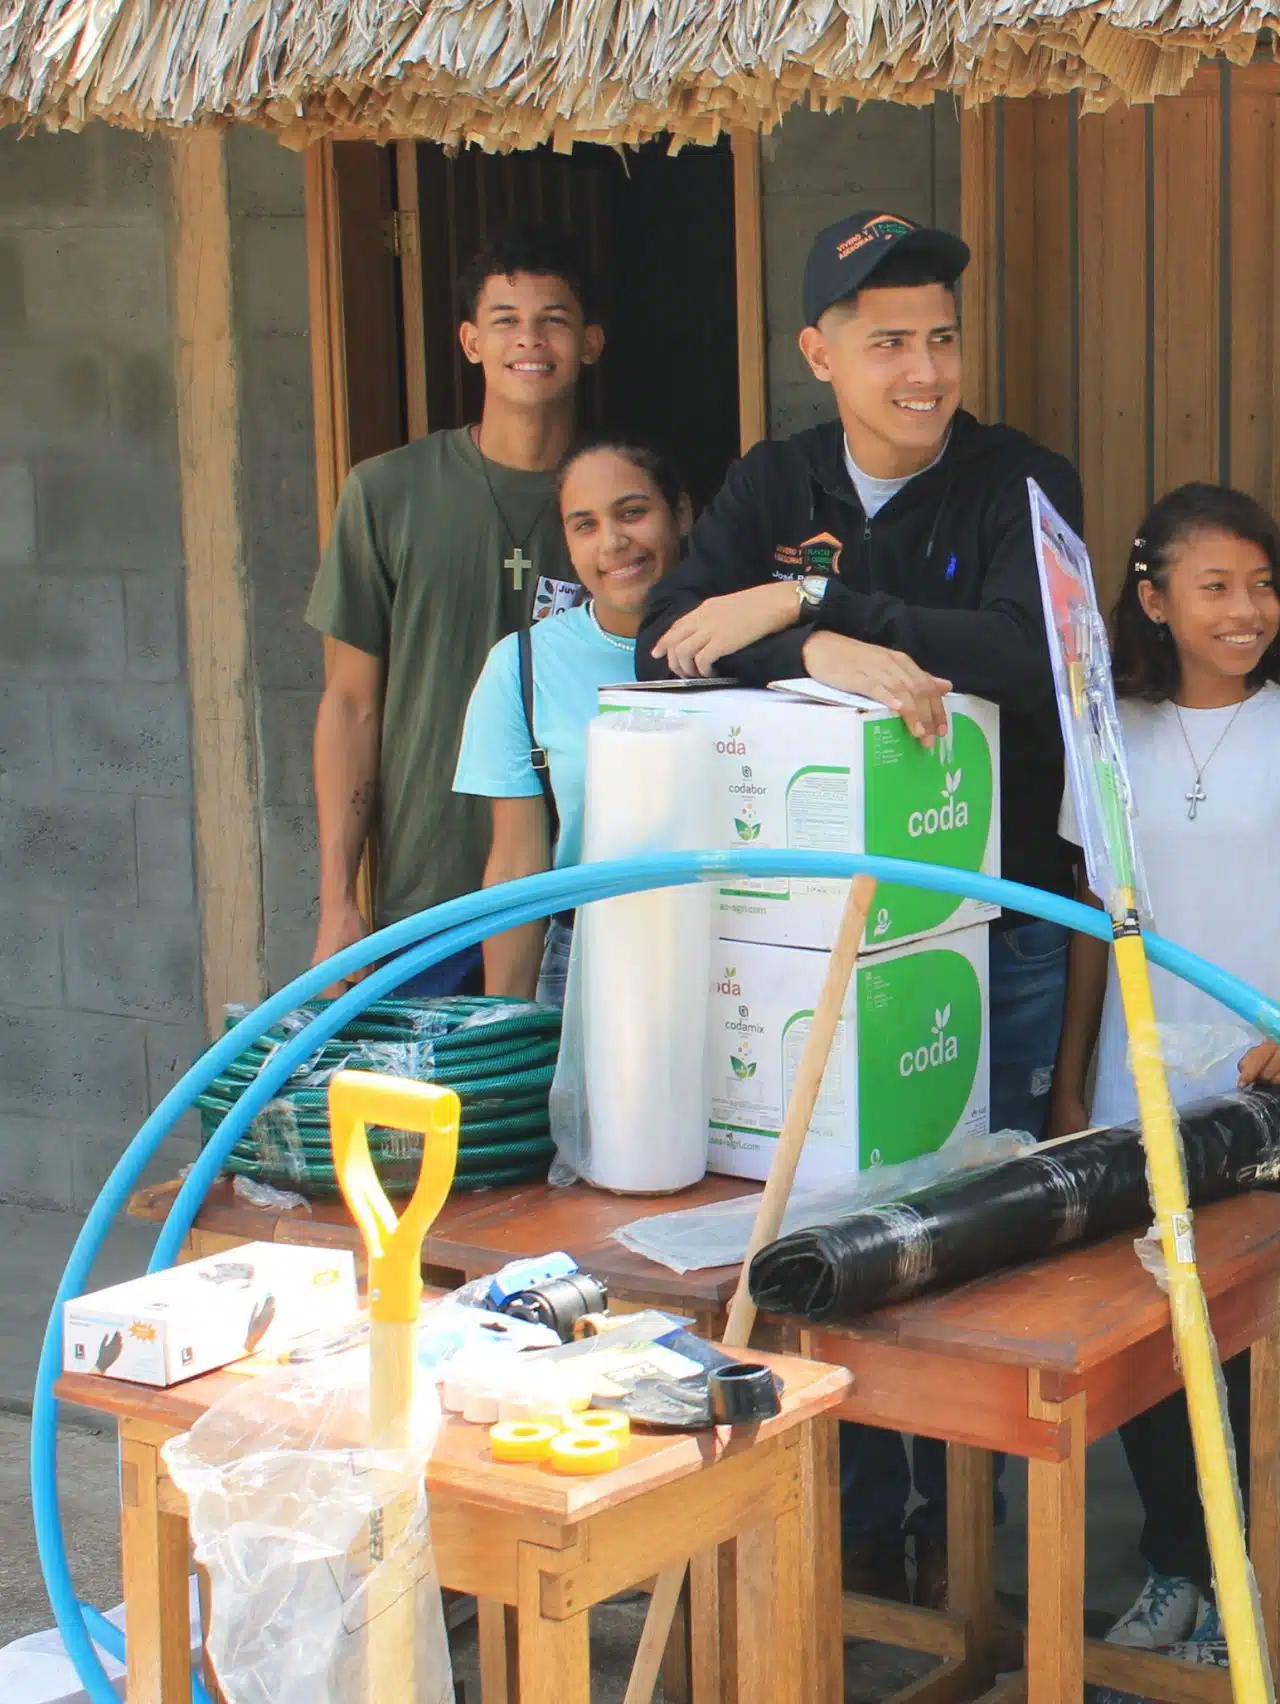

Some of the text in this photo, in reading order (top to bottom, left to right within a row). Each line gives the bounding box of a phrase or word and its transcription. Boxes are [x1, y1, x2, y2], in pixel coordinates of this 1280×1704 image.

[559, 585, 576, 595] Juv
[713, 739, 746, 755] oda
[728, 783, 767, 795] codabor
[908, 796, 968, 837] coda
[725, 1021, 764, 1034] codamix
[900, 1031, 959, 1077] coda
